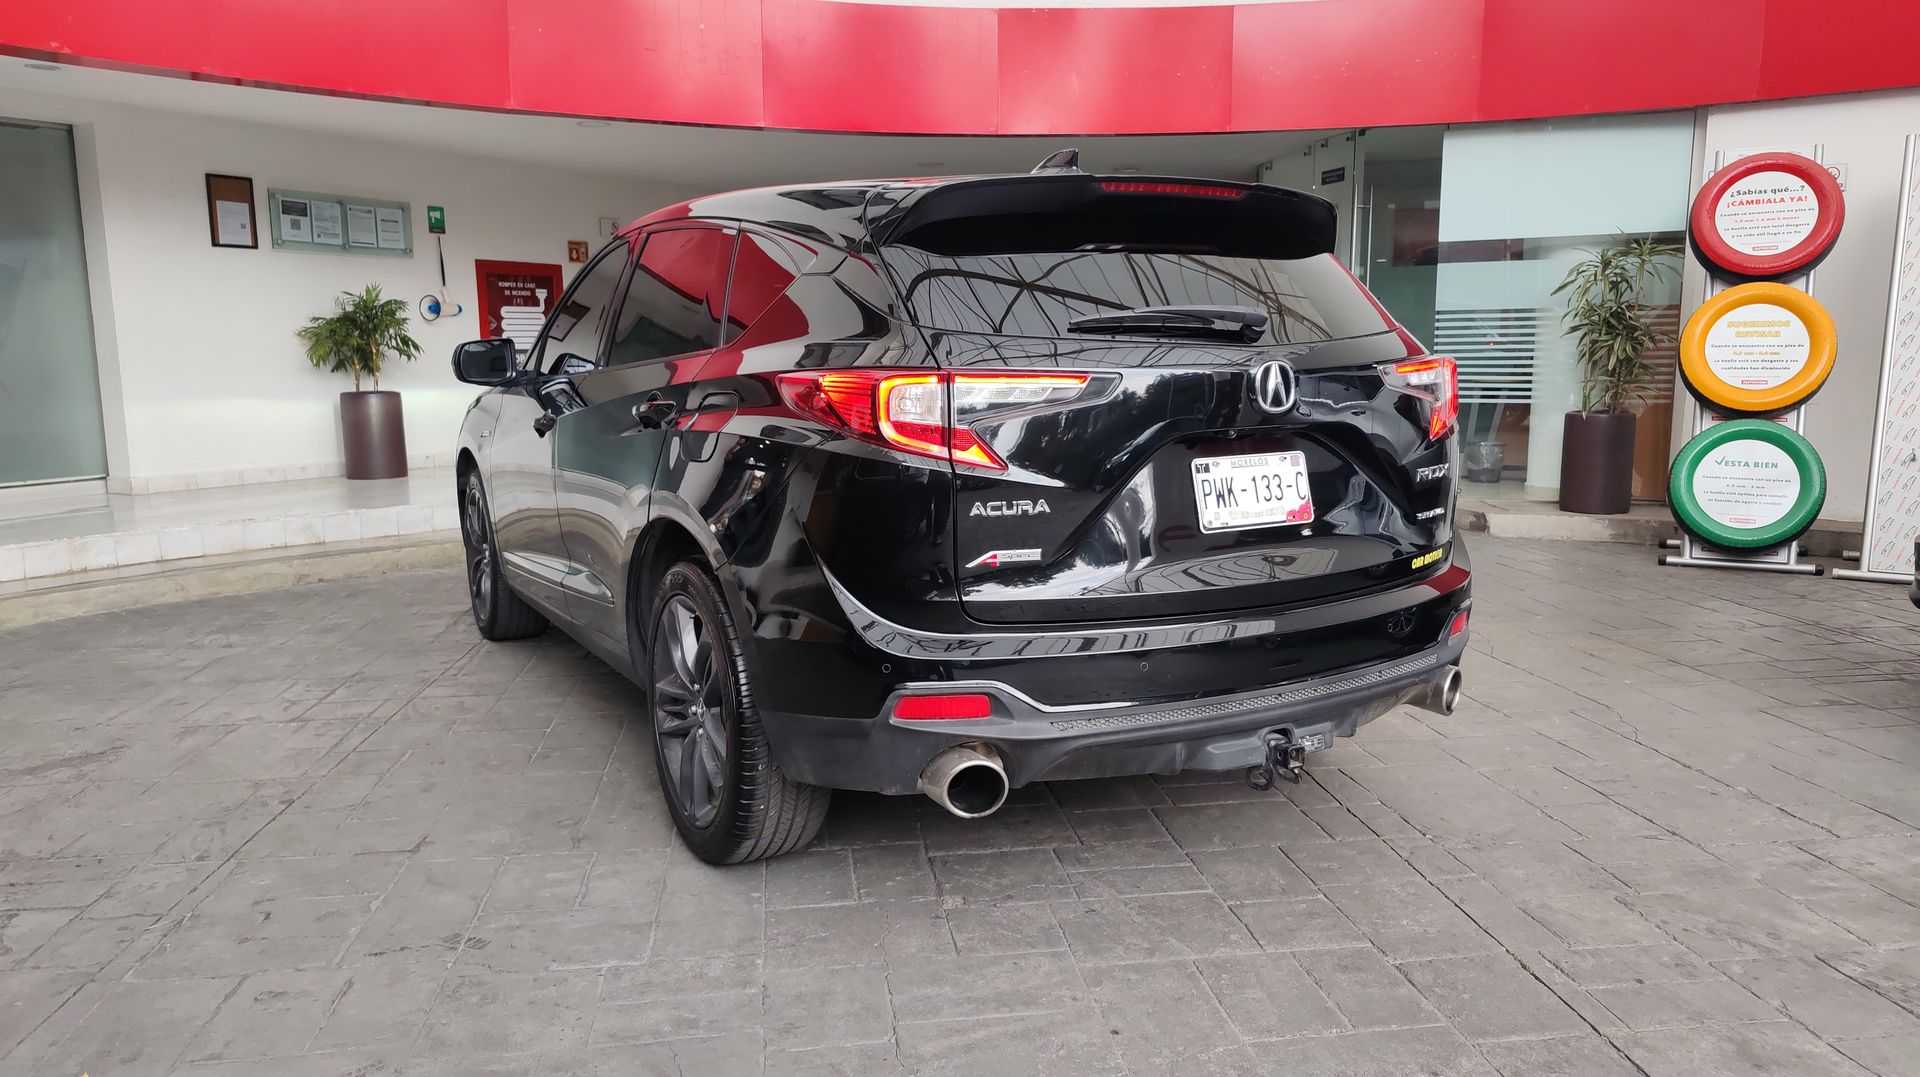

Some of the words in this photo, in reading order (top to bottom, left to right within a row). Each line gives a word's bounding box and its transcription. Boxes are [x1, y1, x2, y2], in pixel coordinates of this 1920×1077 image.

[1730, 188, 1767, 198] ¿Sabías
[1230, 457, 1268, 467] MORELOS
[1416, 463, 1449, 483] RDX
[1202, 472, 1307, 510] PWK-133-C
[969, 498, 1051, 516] ACURA
